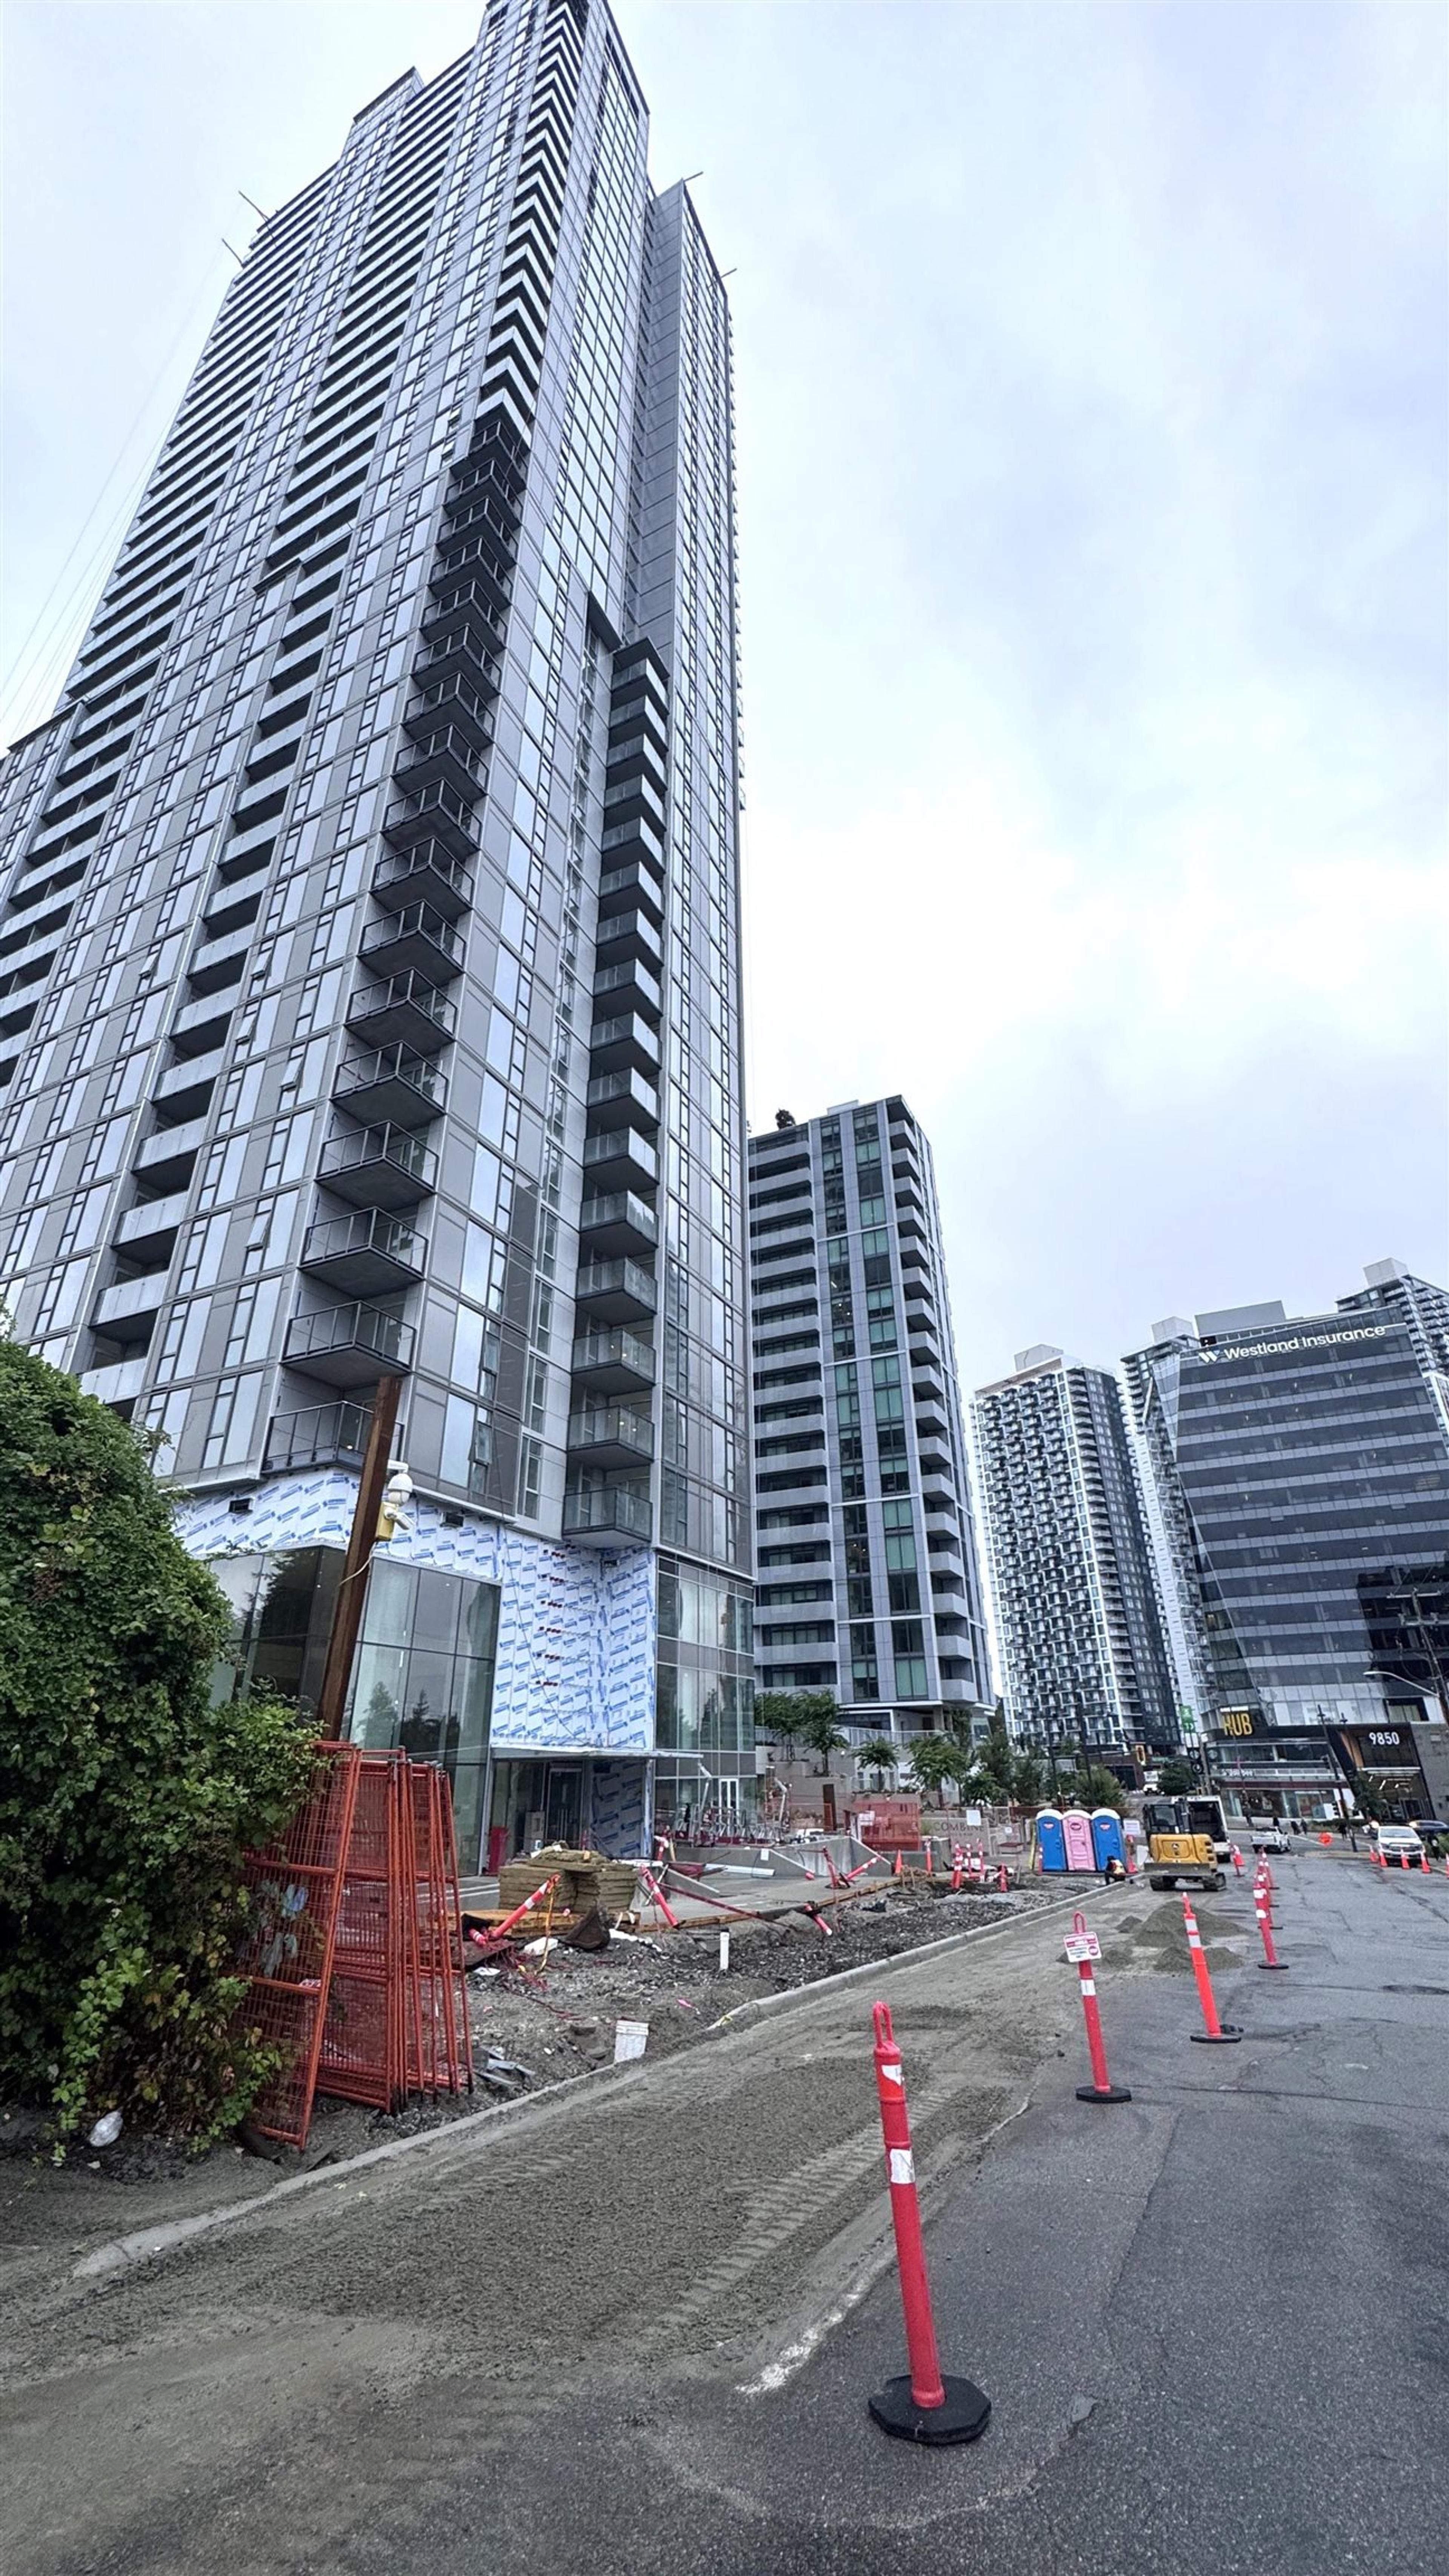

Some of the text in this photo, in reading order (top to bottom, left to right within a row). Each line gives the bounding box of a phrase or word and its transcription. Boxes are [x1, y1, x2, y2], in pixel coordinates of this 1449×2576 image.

[1224, 1338, 1298, 1359] Westland
[1303, 1326, 1386, 1347] Insurance
[1223, 1713, 1252, 1736] HUB
[1369, 1732, 1400, 1744] 9850
